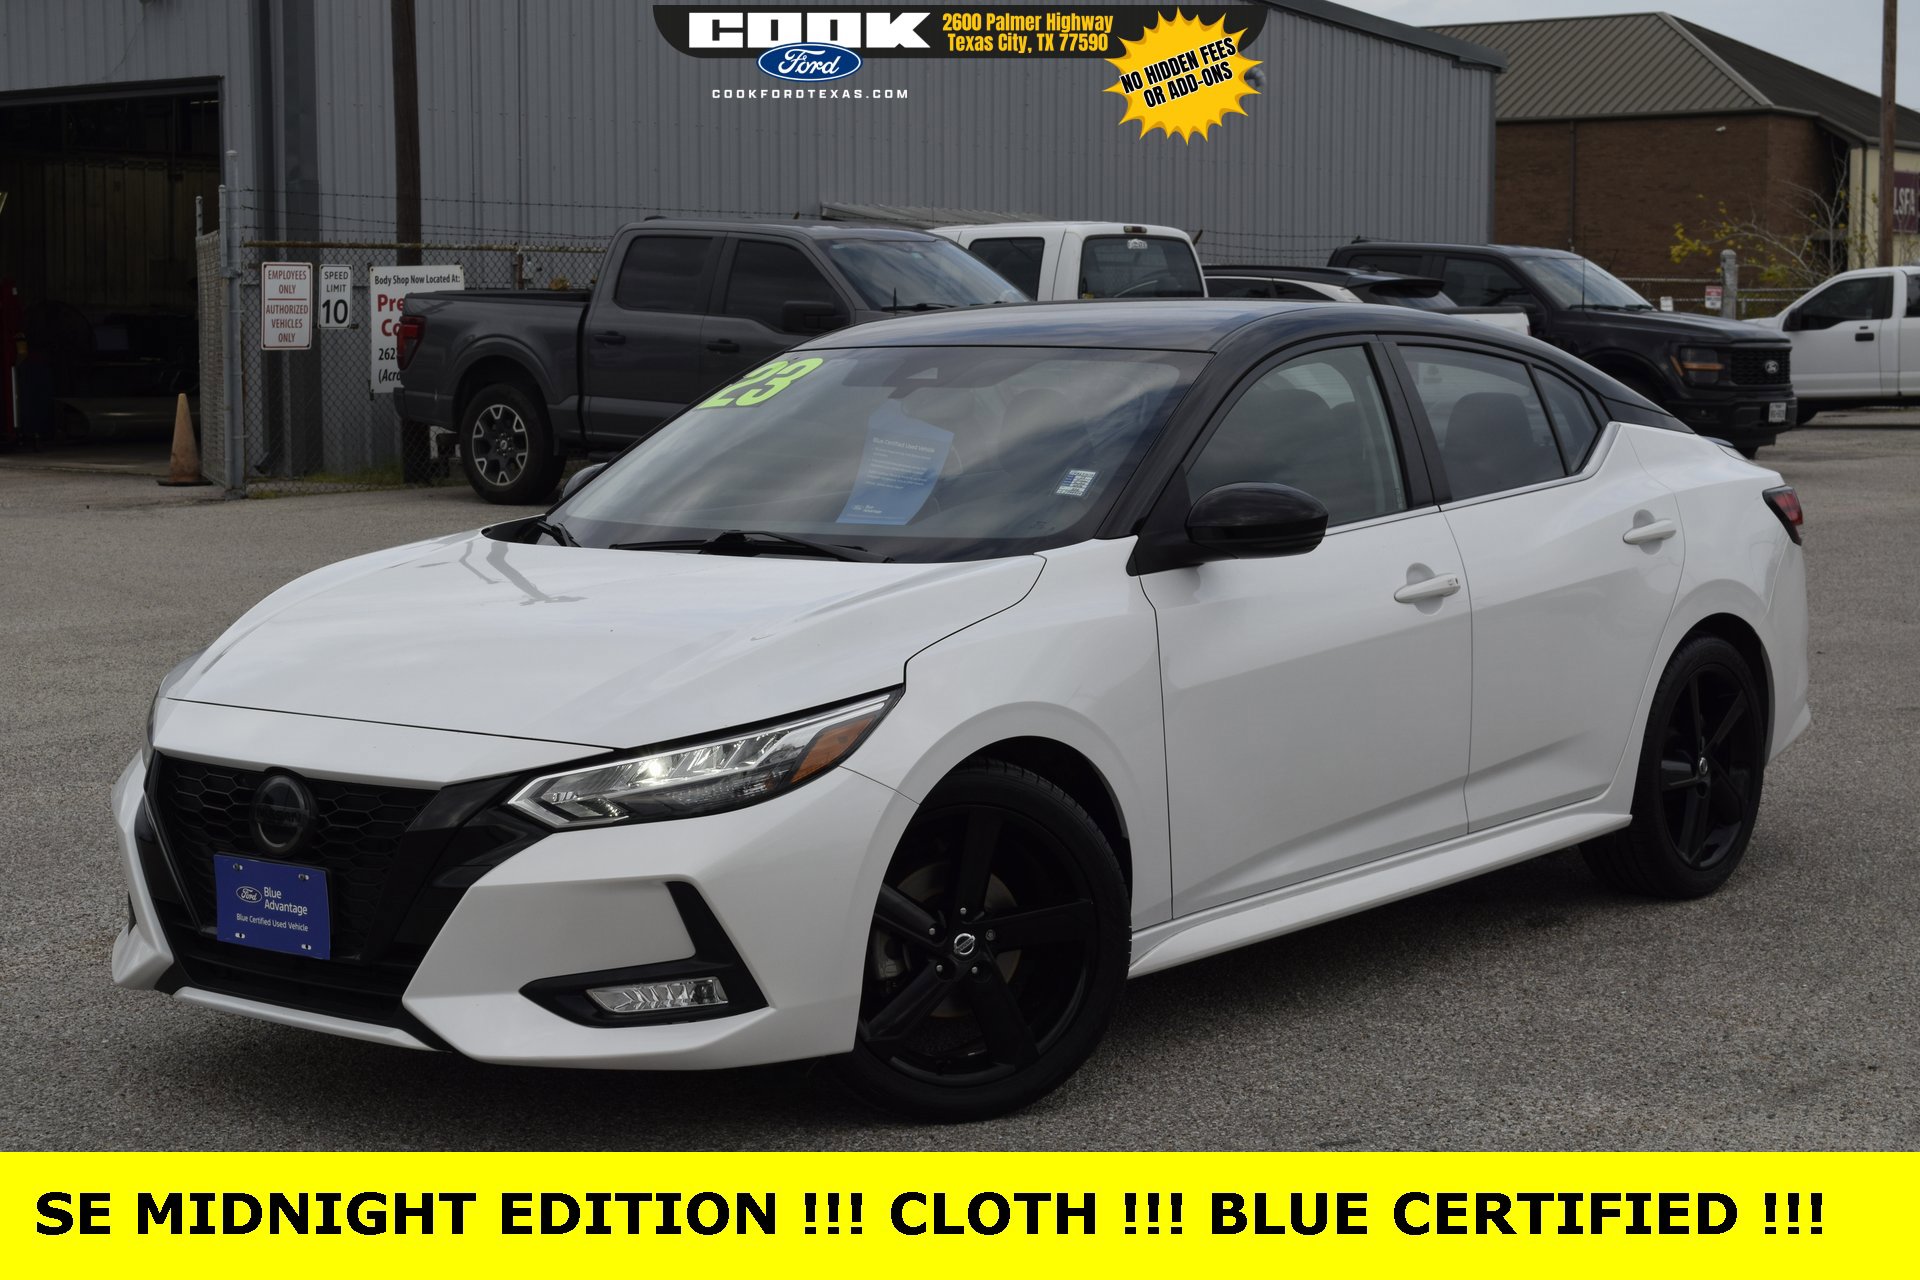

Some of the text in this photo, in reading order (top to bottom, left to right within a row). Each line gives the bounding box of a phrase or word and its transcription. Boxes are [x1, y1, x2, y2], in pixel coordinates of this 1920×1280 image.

[268, 270, 307, 280] EMPLOYEES
[324, 271, 349, 280] SPEED
[375, 274, 460, 286] Body Shop Now Located At:
[278, 284, 297, 294] ONLY
[326, 284, 347, 293] LIMIT
[266, 304, 309, 315] AUTHORIZED
[322, 299, 349, 324] 10
[271, 319, 303, 328] VEHICLES
[278, 333, 296, 343] ONLY
[696, 358, 824, 409] 23
[263, 886, 282, 899] Blue
[264, 899, 308, 916] Advantage
[236, 913, 309, 932] Blue Certified Used Vehicle
